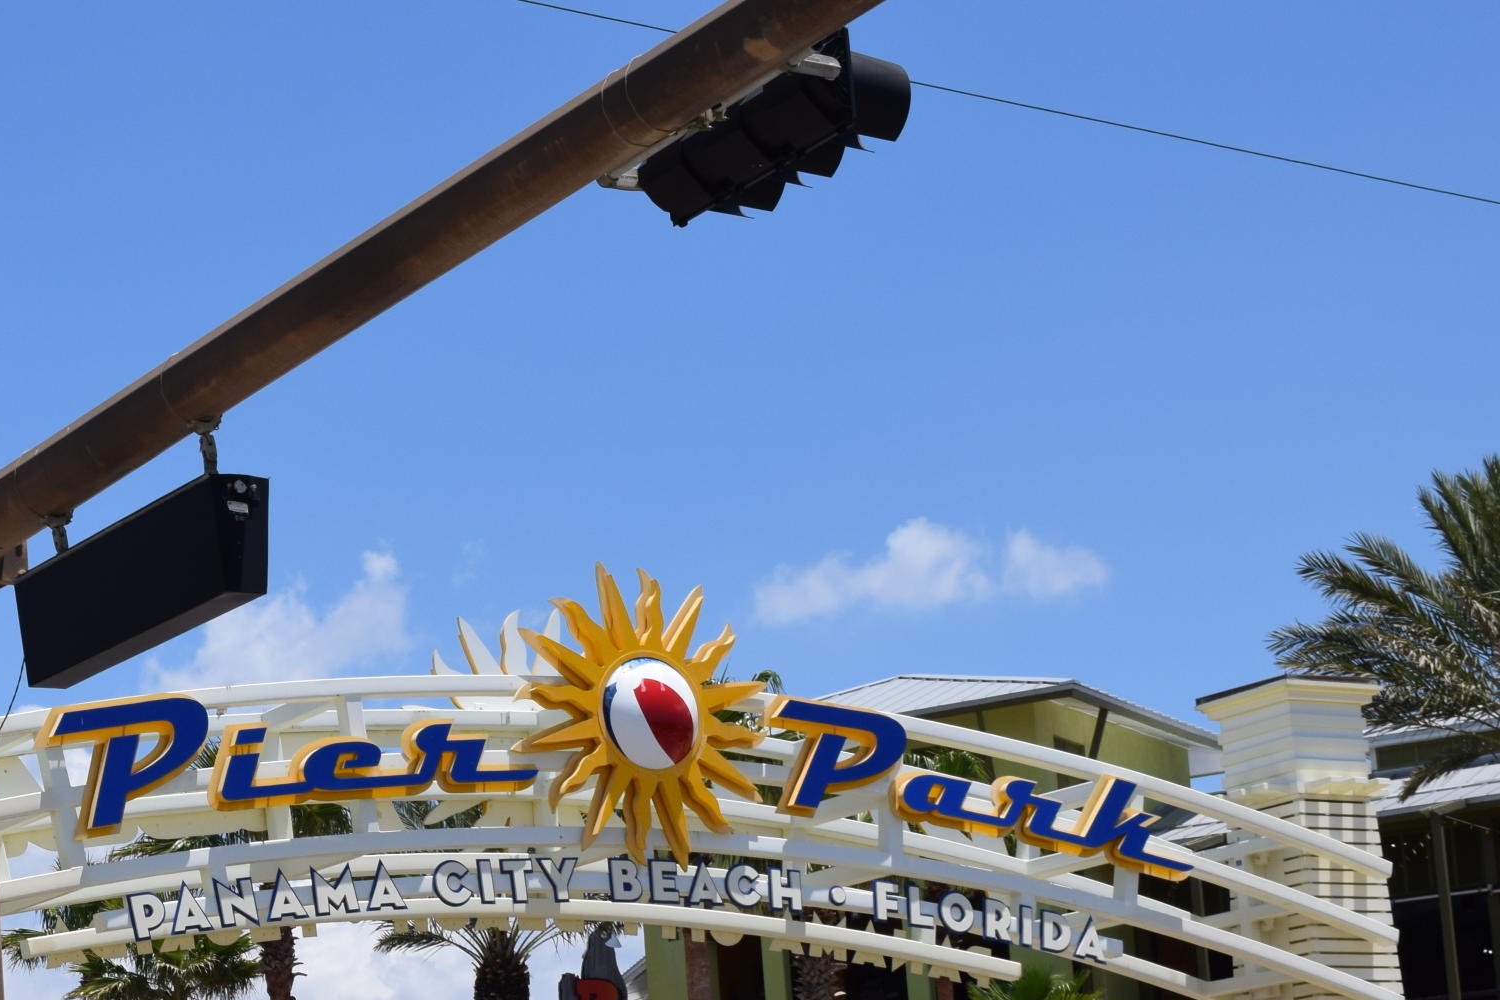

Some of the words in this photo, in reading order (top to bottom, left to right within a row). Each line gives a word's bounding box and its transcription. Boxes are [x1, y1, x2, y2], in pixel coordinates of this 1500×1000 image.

[36, 693, 539, 839] Pier
[760, 695, 1194, 881] Park
[127, 859, 408, 941] PANAMA
[432, 857, 579, 906] CITY
[607, 858, 803, 913] BEACH
[873, 880, 1107, 966] FLORIDA
